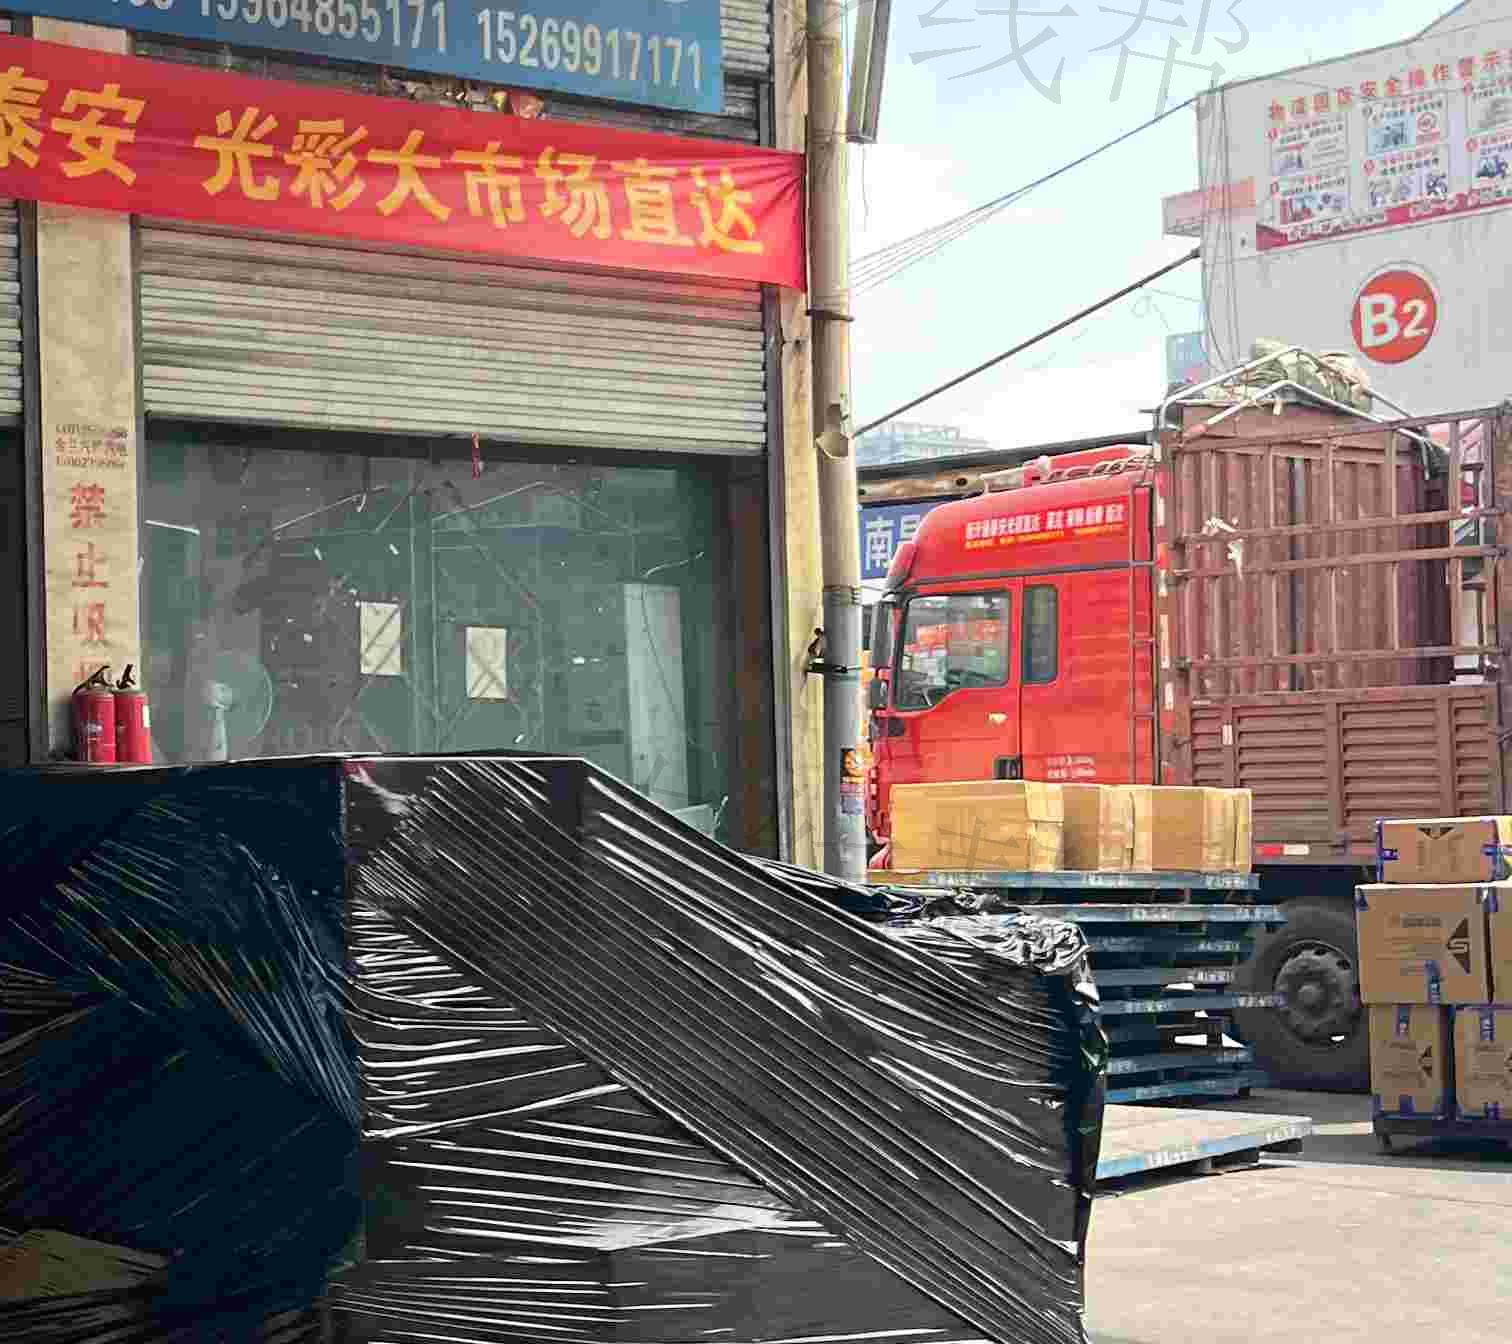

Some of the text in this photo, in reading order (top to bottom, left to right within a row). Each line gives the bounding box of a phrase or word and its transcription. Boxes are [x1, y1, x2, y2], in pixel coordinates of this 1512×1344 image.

[476, 8, 704, 90] 15269917171
[193, 106, 766, 255] 光彩大市场直达
[1357, 294, 1429, 348] B2
